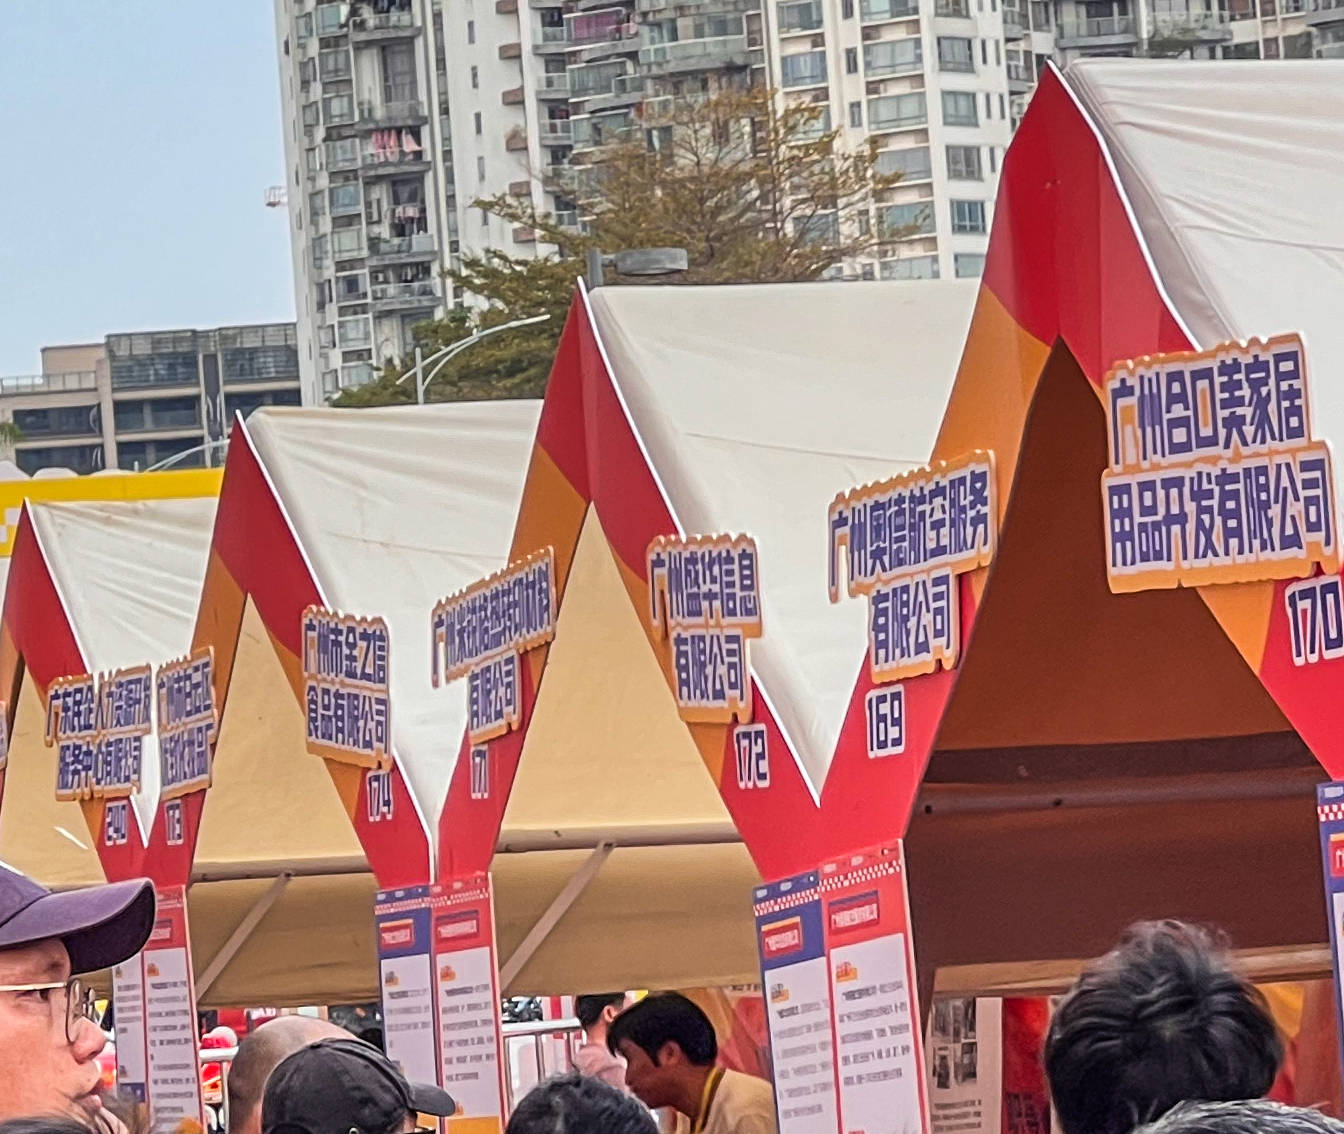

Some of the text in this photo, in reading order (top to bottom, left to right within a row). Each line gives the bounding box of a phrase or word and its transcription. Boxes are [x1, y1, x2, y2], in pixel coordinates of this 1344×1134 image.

[1111, 350, 1304, 465] 广州合口美家居
[831, 469, 989, 587] 广州奥德航空服务
[1108, 458, 1331, 567] 用品开发有限公司
[650, 548, 759, 620] 广州盛华信息
[871, 571, 951, 665] 有限公司
[1288, 581, 1344, 660] 170
[674, 633, 745, 704] 有限公司
[735, 728, 767, 783] 172
[868, 690, 902, 752] 169
